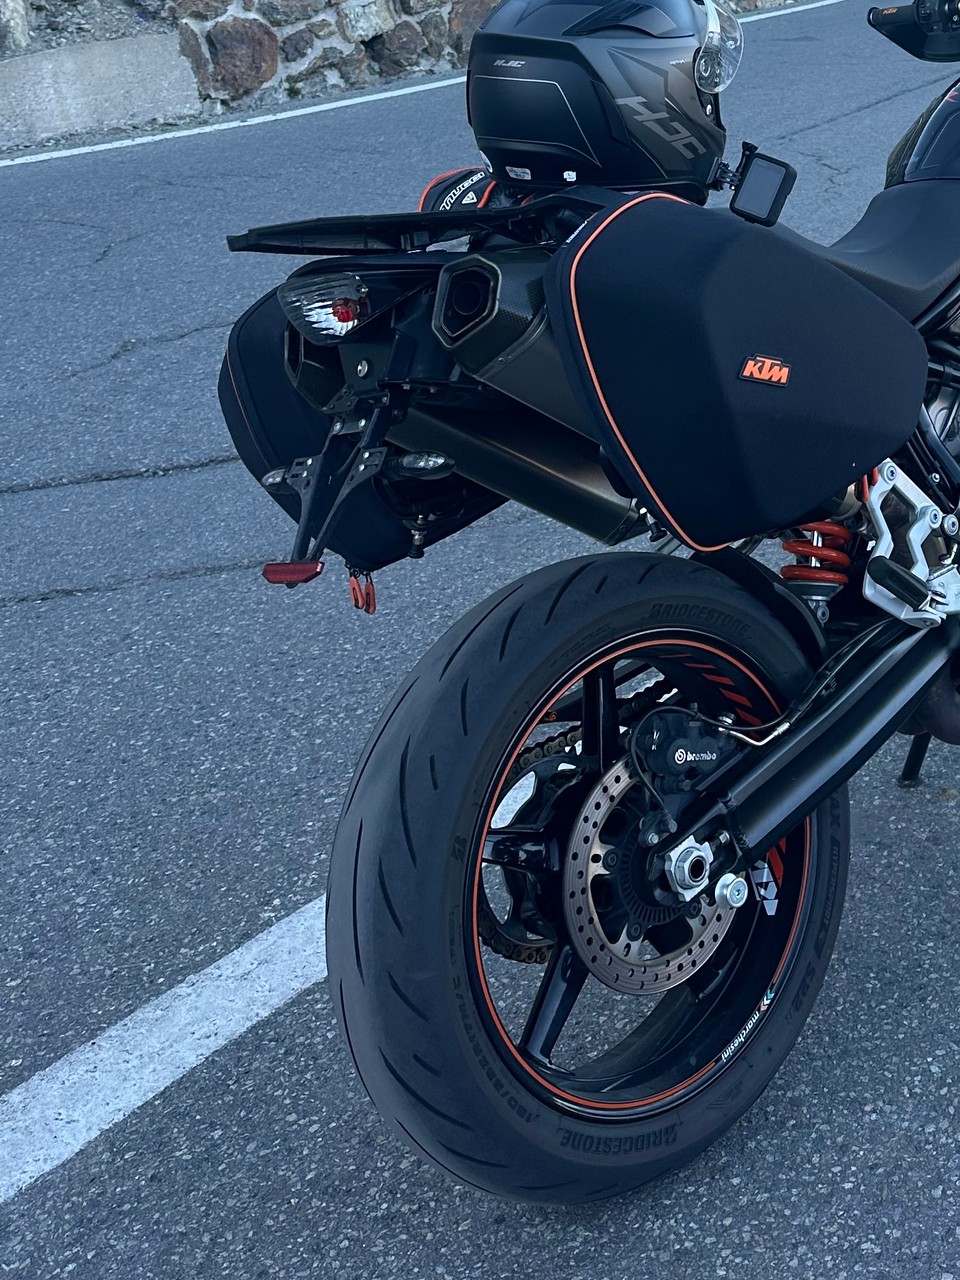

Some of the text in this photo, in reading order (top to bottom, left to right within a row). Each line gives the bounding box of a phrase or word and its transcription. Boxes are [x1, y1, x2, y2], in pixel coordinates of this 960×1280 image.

[614, 95, 708, 160] HJC
[742, 355, 790, 384] KTM
[647, 602, 753, 637] BRIDGESTONE
[720, 1009, 762, 1063] marchesini
[560, 1121, 680, 1156] BRIDGESTONE
